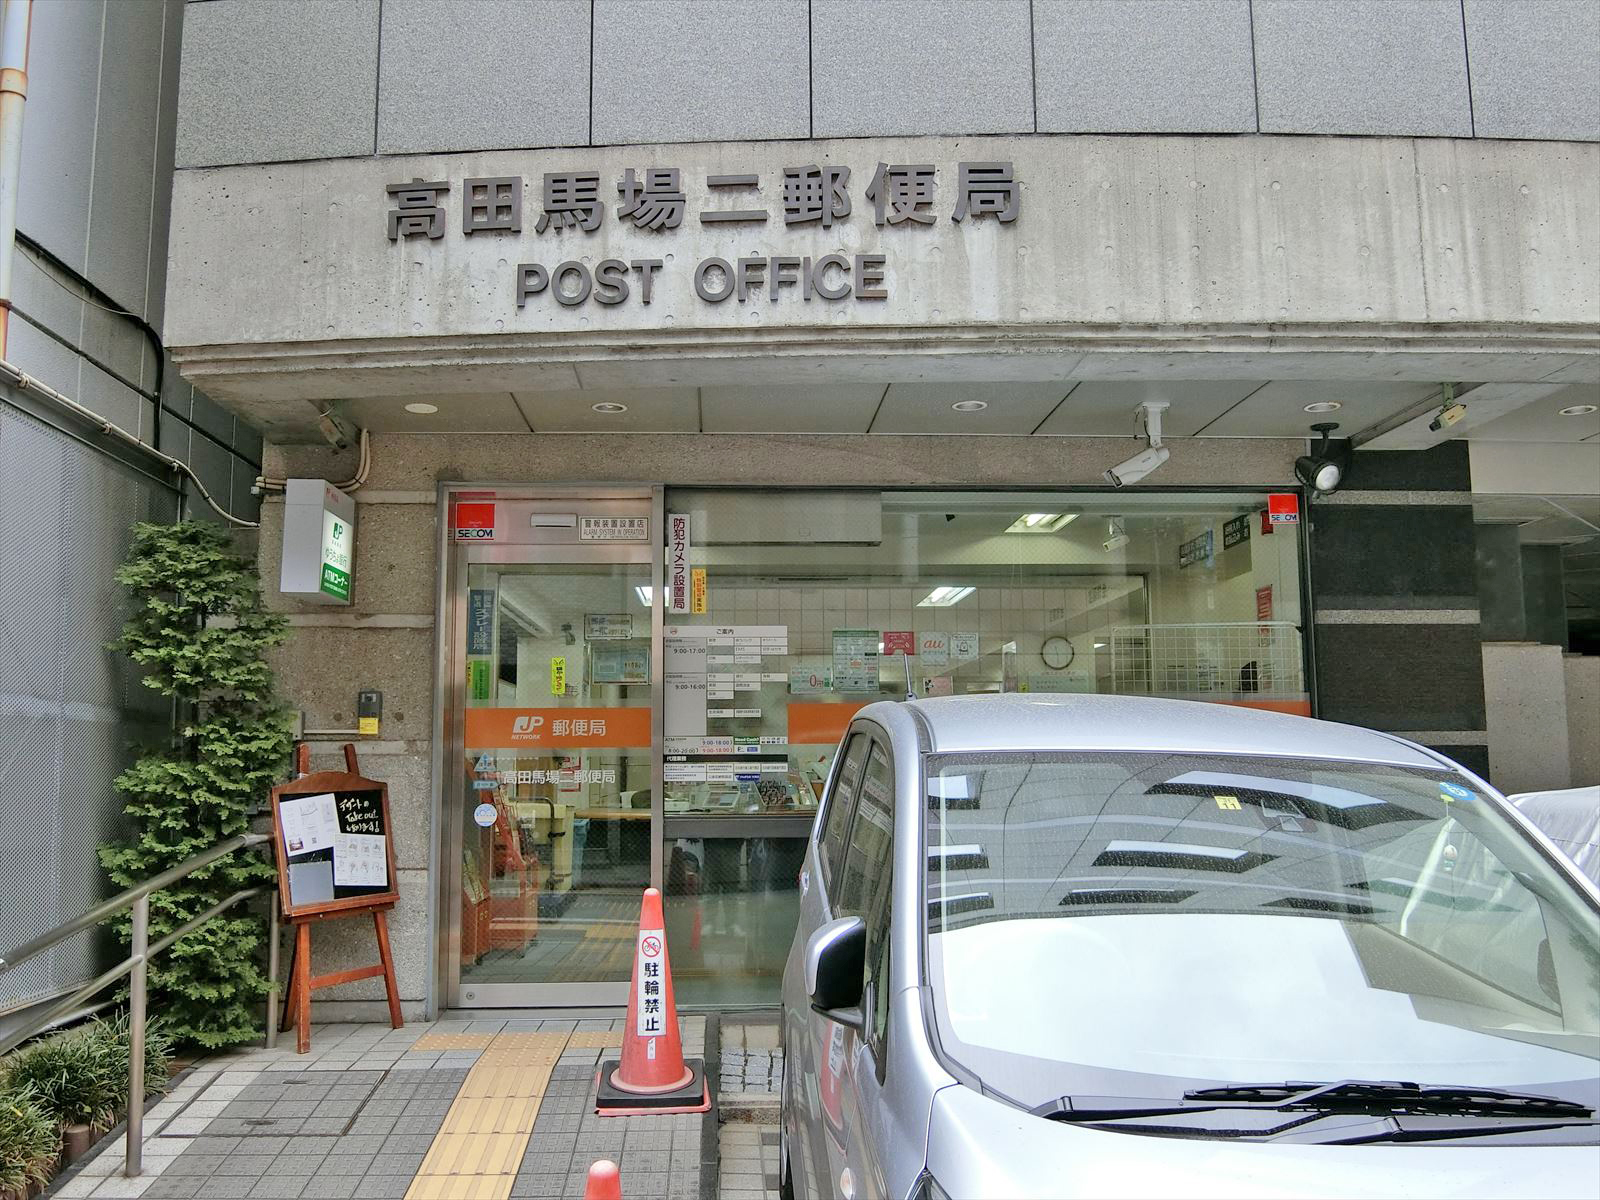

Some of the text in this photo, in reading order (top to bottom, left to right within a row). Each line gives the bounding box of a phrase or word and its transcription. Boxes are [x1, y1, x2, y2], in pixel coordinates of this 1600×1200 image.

[386, 162, 1020, 240] 高田馬場二郵便局
[516, 255, 888, 308] POST OFFICE
[584, 519, 645, 528] 警報装置設置店
[458, 529, 493, 538] SECOM
[673, 517, 686, 610] 防犯カメラ設置局
[923, 639, 945, 649] au
[513, 716, 545, 734] JP
[552, 719, 607, 737] 郵便局
[503, 770, 616, 785] 高田馬場二郵便局
[345, 809, 378, 822] Take out
[644, 962, 660, 1032] 駐輪禁止
